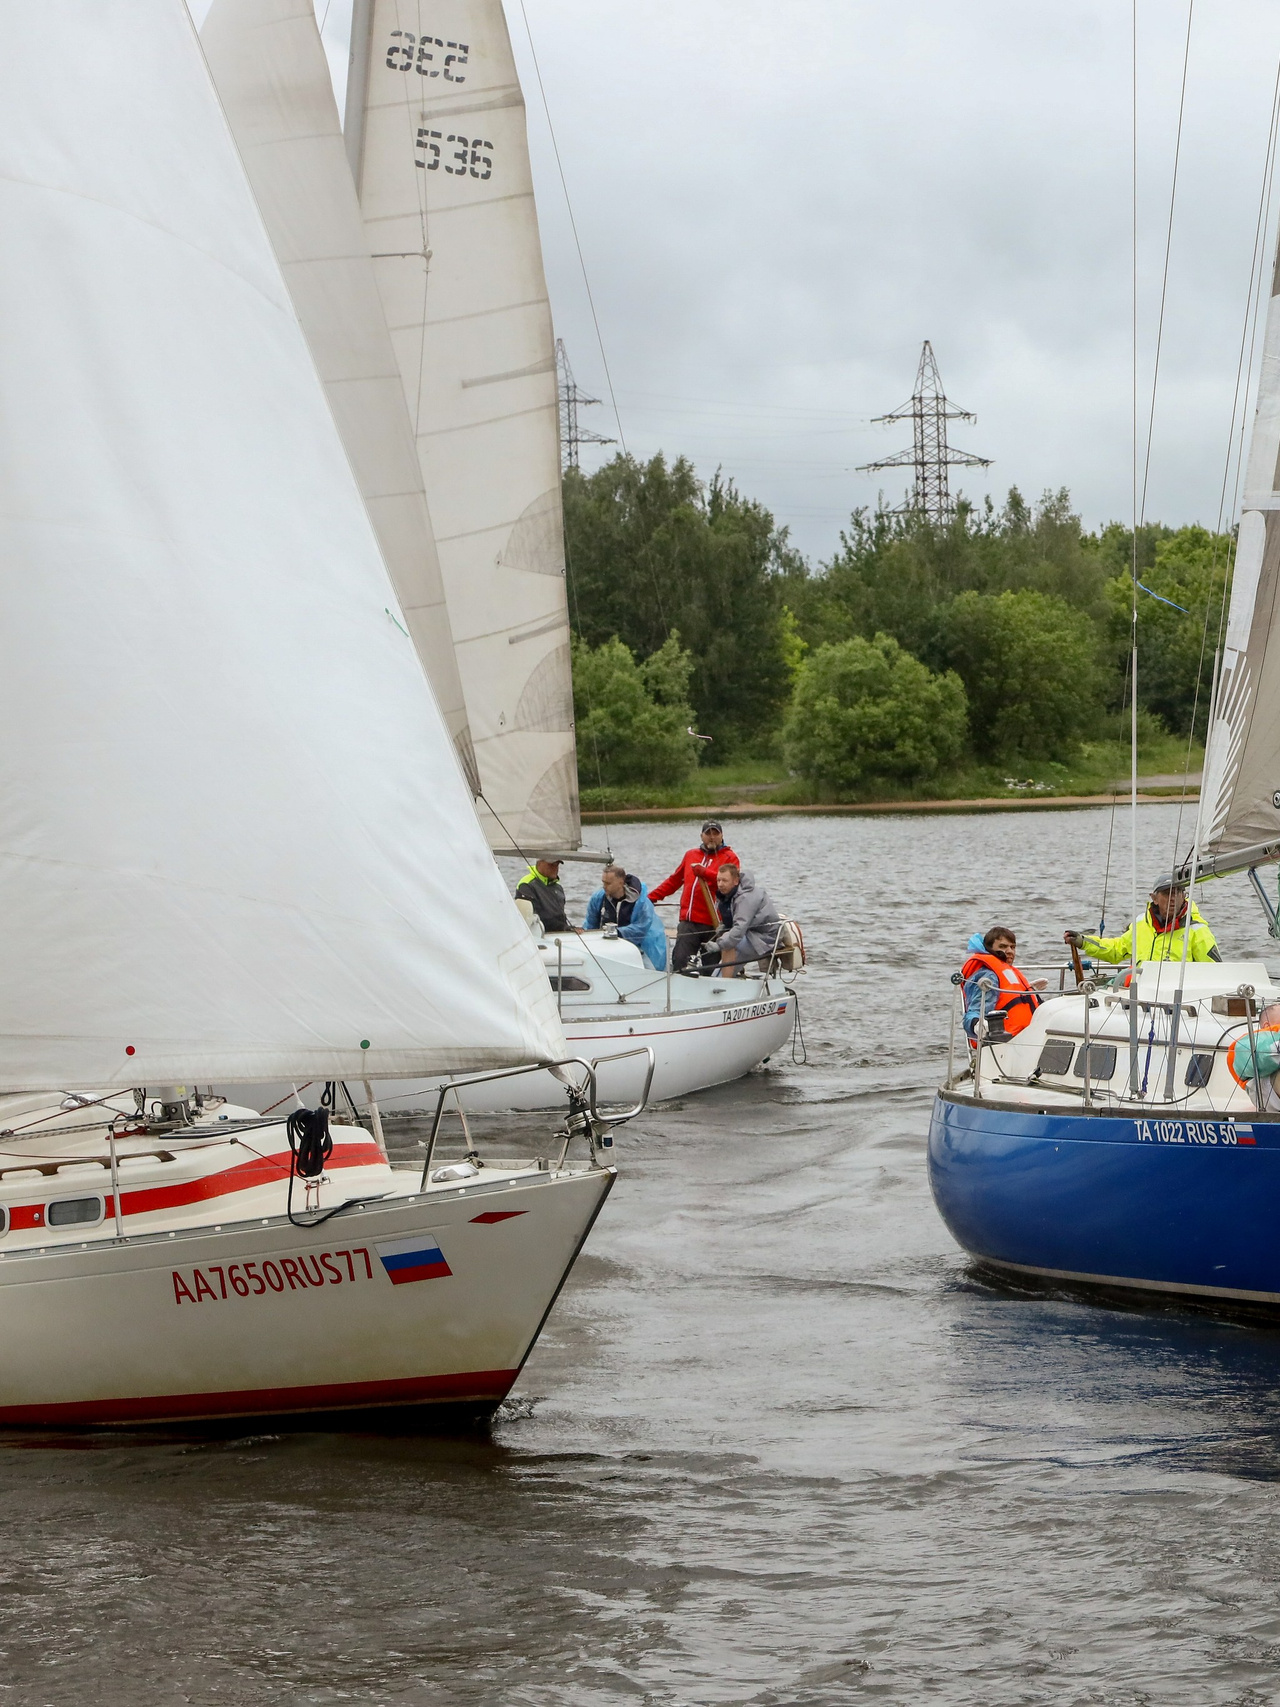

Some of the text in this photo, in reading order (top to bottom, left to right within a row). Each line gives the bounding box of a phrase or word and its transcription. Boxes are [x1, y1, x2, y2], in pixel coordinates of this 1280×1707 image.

[414, 128, 494, 180] 536
[722, 1002, 777, 1022] TA 2071 RUS 50
[1134, 1120, 1238, 1145] TA 1022 RUS 50
[172, 1248, 373, 1304] AA7650RUS77
